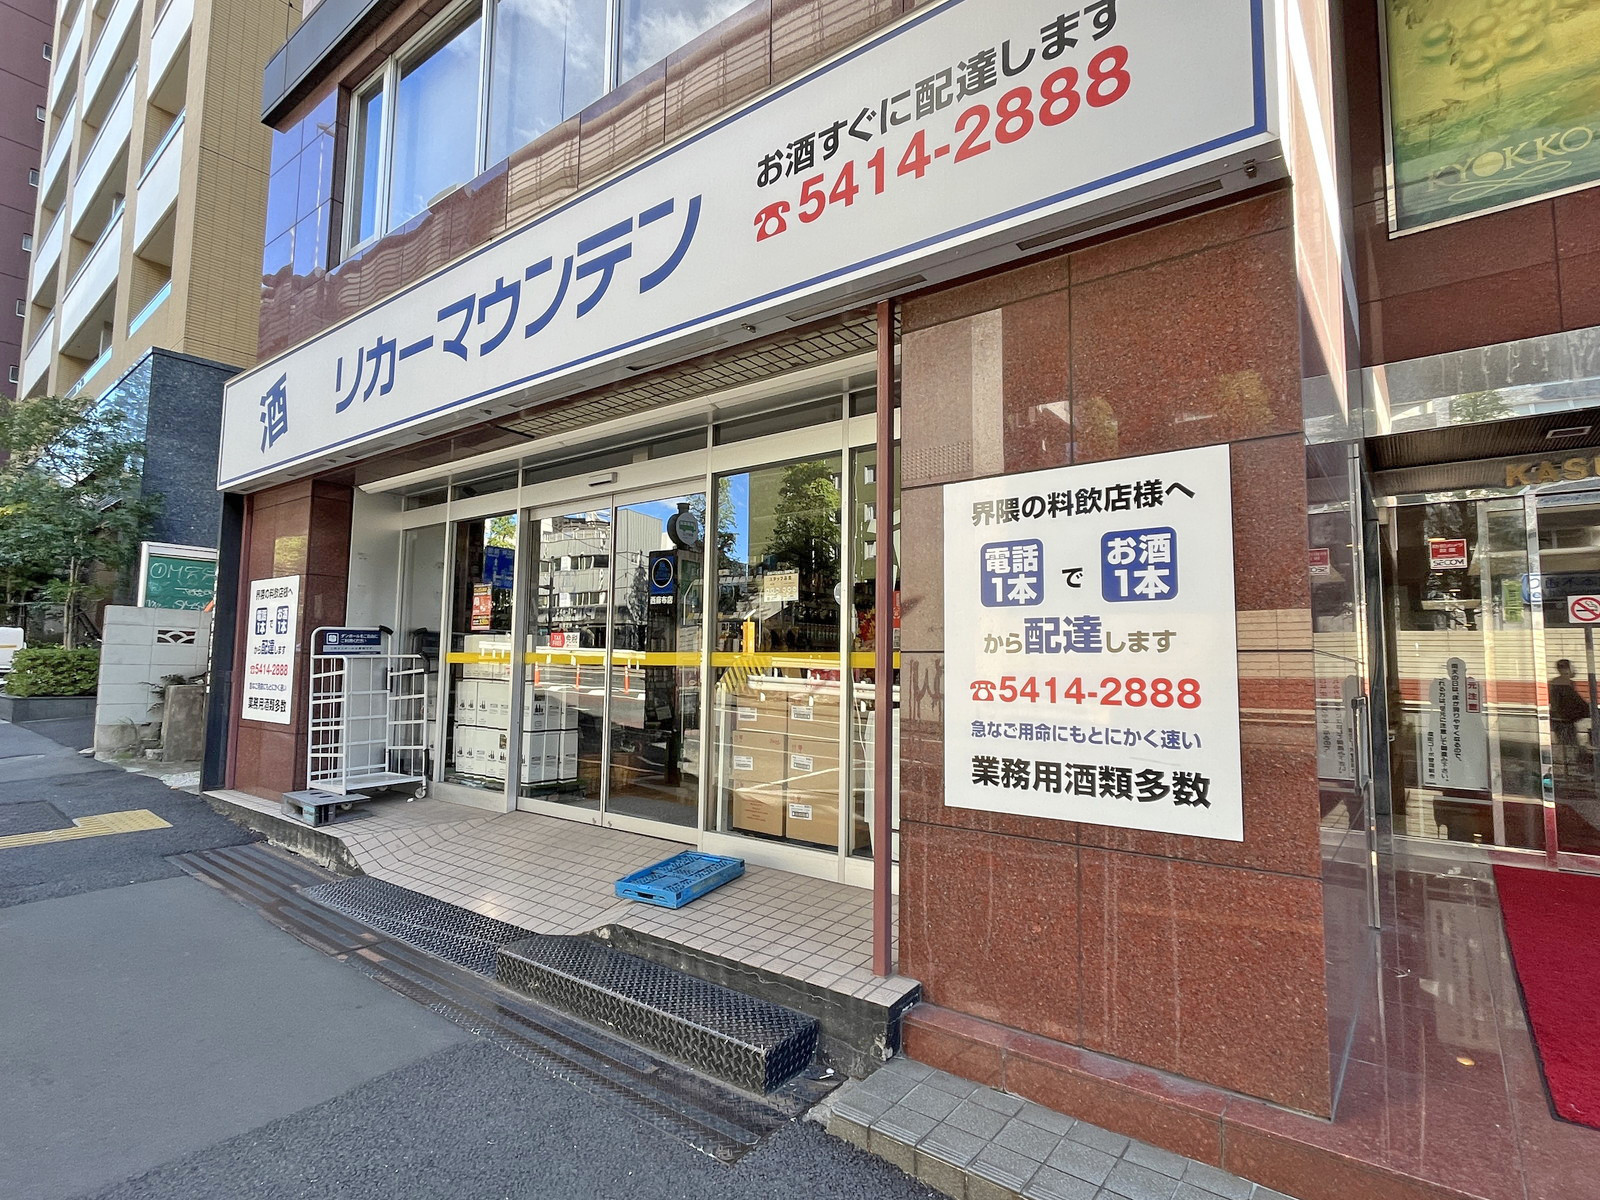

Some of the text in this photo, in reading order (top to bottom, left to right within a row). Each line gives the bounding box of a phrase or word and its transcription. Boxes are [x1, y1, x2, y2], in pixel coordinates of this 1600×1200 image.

[757, 0, 1117, 187] お酒すぐに配達します
[797, 45, 1131, 223] 5414-2888
[260, 194, 702, 453] 酒 リカーマウンテン
[971, 478, 1196, 527] 界隈の料飲店様へ
[984, 544, 1039, 573] 電話
[1106, 532, 1171, 565] お酒
[991, 574, 1038, 605] 1本
[1062, 567, 1084, 589] で
[1114, 565, 1171, 599] 1本
[983, 615, 1177, 654] から配達します
[999, 676, 1202, 709] 5414-2888
[971, 719, 1202, 750] 急なご用命にもとにかく速い
[971, 755, 1212, 809] 業務用酒類多数
